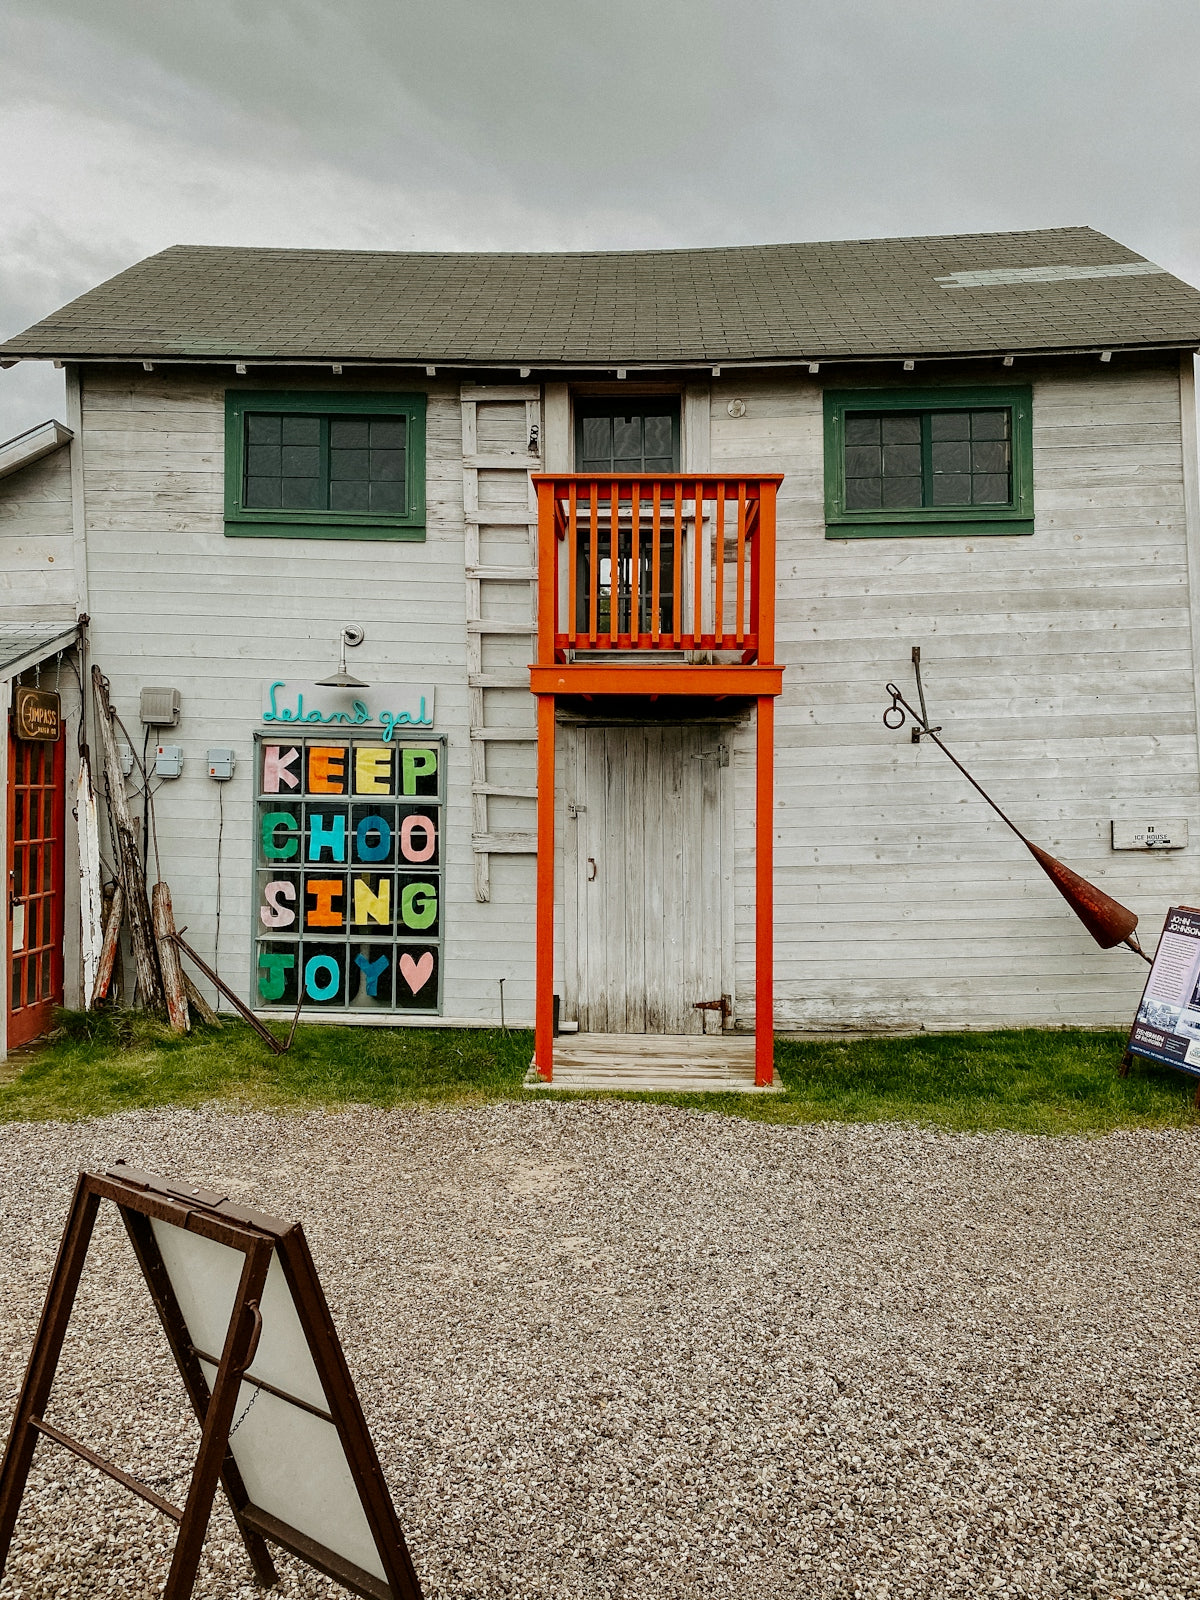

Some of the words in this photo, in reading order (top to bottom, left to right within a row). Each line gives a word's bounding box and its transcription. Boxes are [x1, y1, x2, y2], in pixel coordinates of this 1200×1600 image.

[263, 681, 373, 724] Leland
[379, 696, 432, 743] gal
[263, 746, 437, 795] KEEP
[262, 812, 435, 863] CHOO
[1146, 833, 1168, 841] HOUSE
[260, 878, 437, 930] SING
[1170, 915, 1191, 926] JOHN
[259, 953, 389, 1001] JOY
